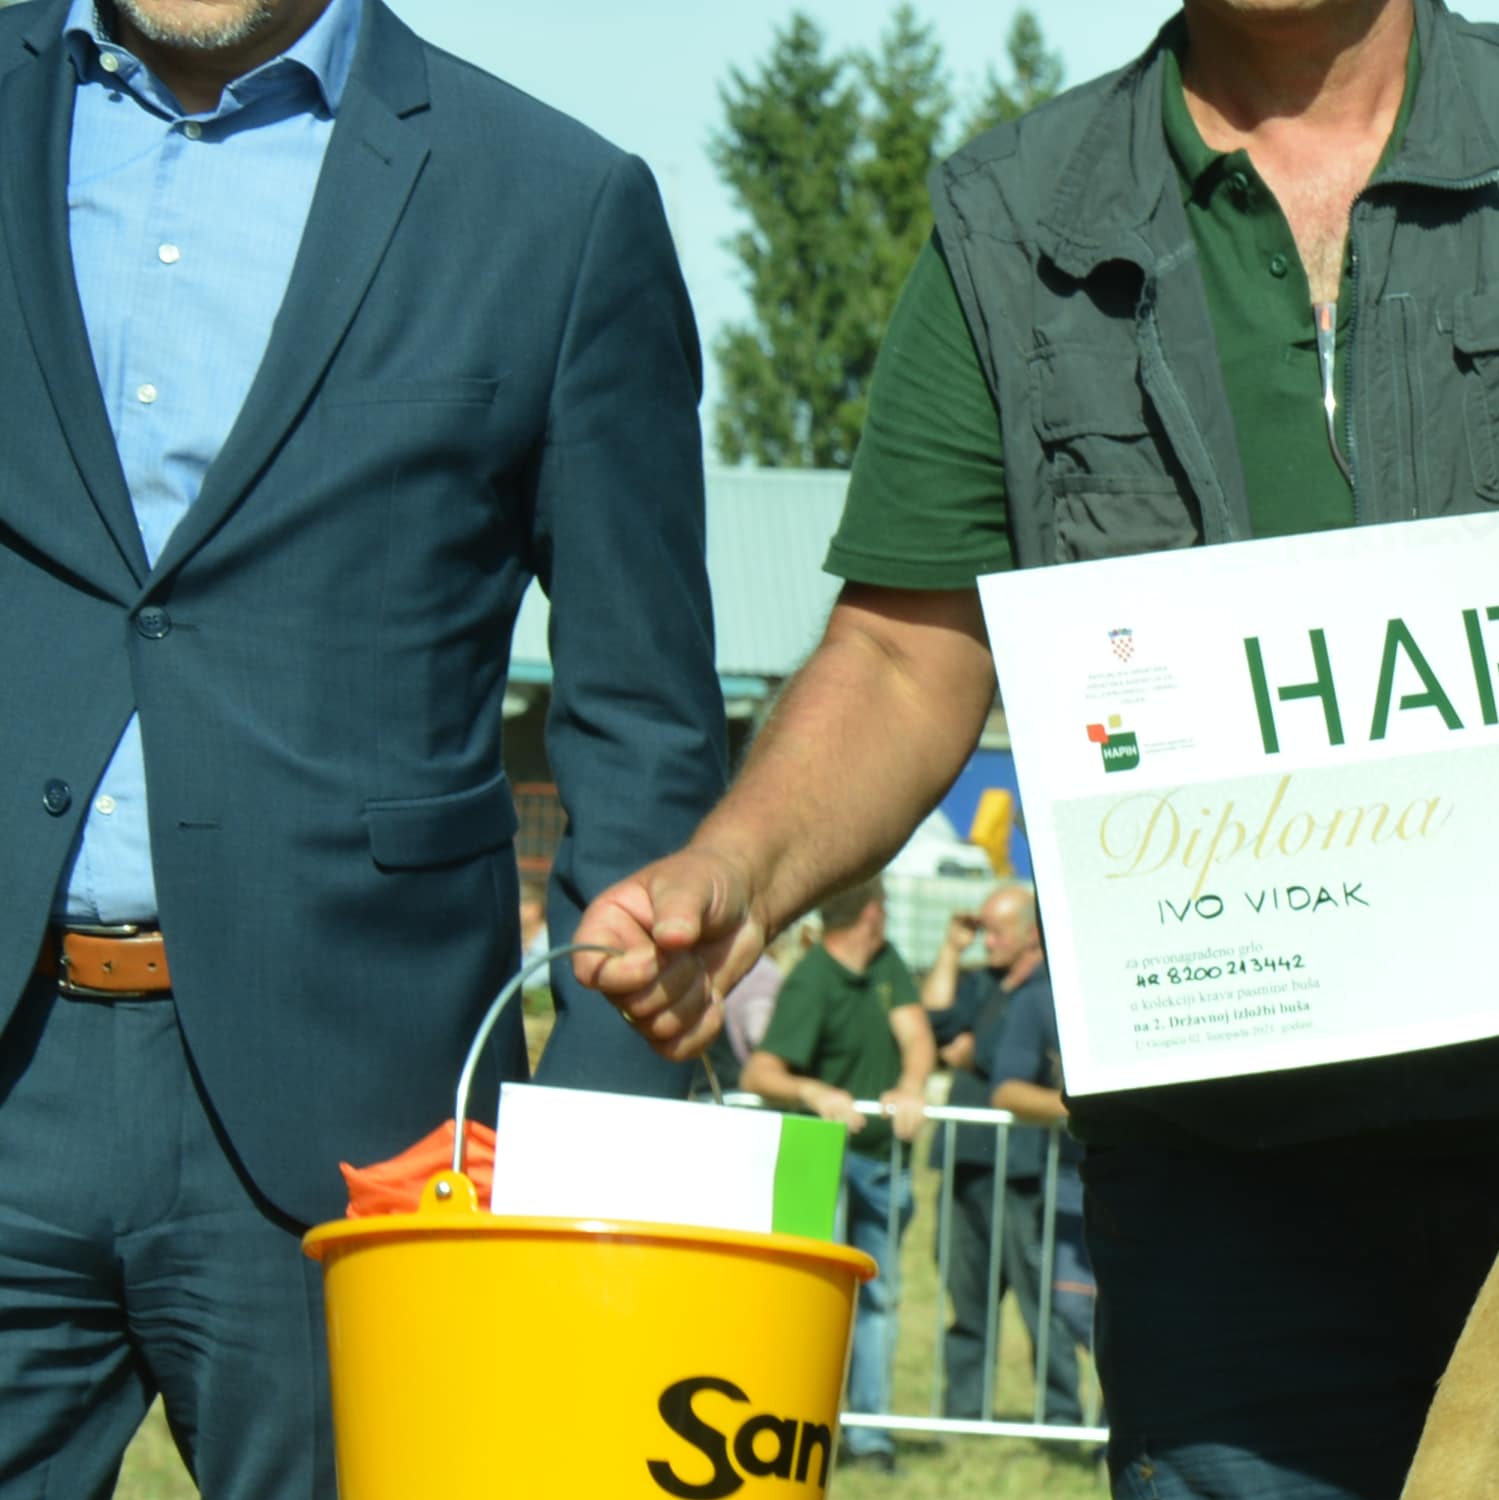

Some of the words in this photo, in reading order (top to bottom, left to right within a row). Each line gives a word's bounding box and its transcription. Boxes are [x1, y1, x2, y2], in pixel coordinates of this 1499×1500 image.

[1103, 744, 1138, 760] HAPIH
[1099, 774, 1455, 900] Diploma
[1158, 894, 1225, 924] IVO
[1245, 882, 1371, 914] VIDAK
[1238, 941, 1264, 960] grlo
[1199, 987, 1235, 1004] krava
[1237, 983, 1289, 1001] pasmine
[1133, 1022, 1149, 1033] na
[1169, 1010, 1230, 1029] Državnoj
[1233, 1003, 1276, 1020] izložbi
[1279, 1000, 1311, 1014] buša
